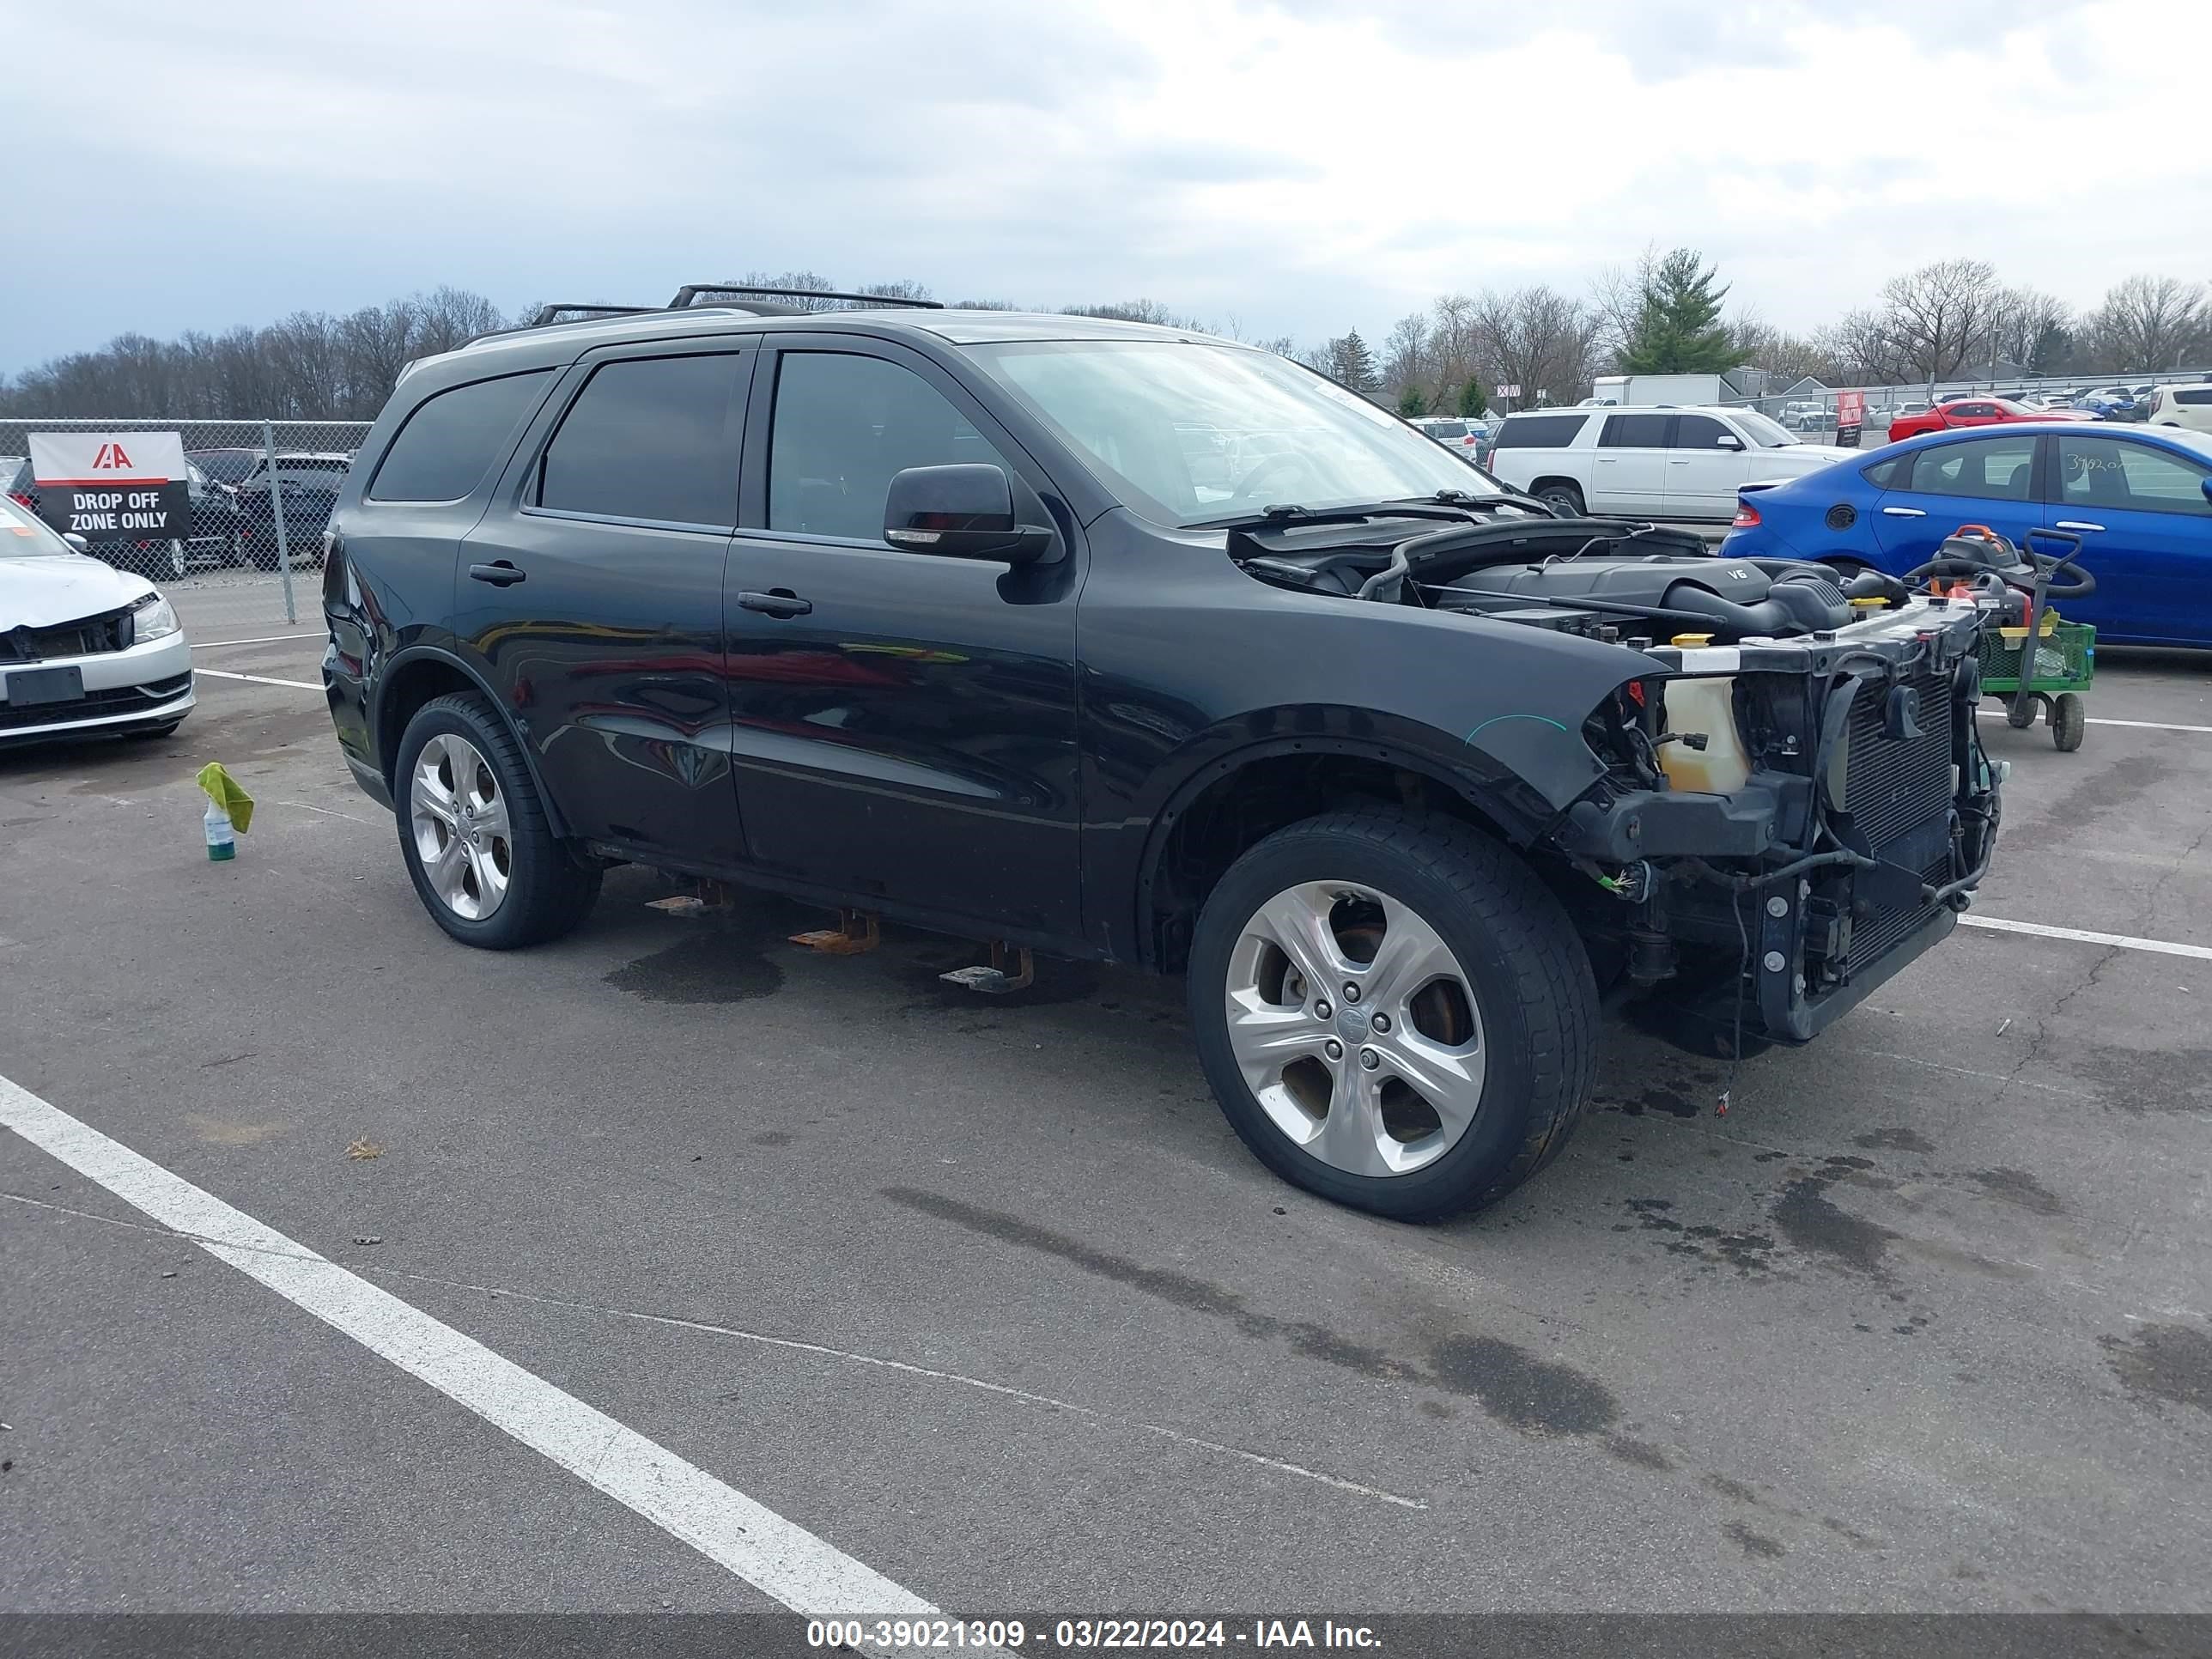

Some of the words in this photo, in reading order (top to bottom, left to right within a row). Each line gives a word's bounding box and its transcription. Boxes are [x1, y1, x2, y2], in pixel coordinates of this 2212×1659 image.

[1498, 386, 1507, 396] X
[1510, 386, 1519, 396] W
[73, 493, 123, 509] DROP
[128, 492, 160, 508] OFF
[70, 514, 118, 530] ZONE
[121, 512, 167, 529] ONLY
[1727, 569, 1748, 580] V6
